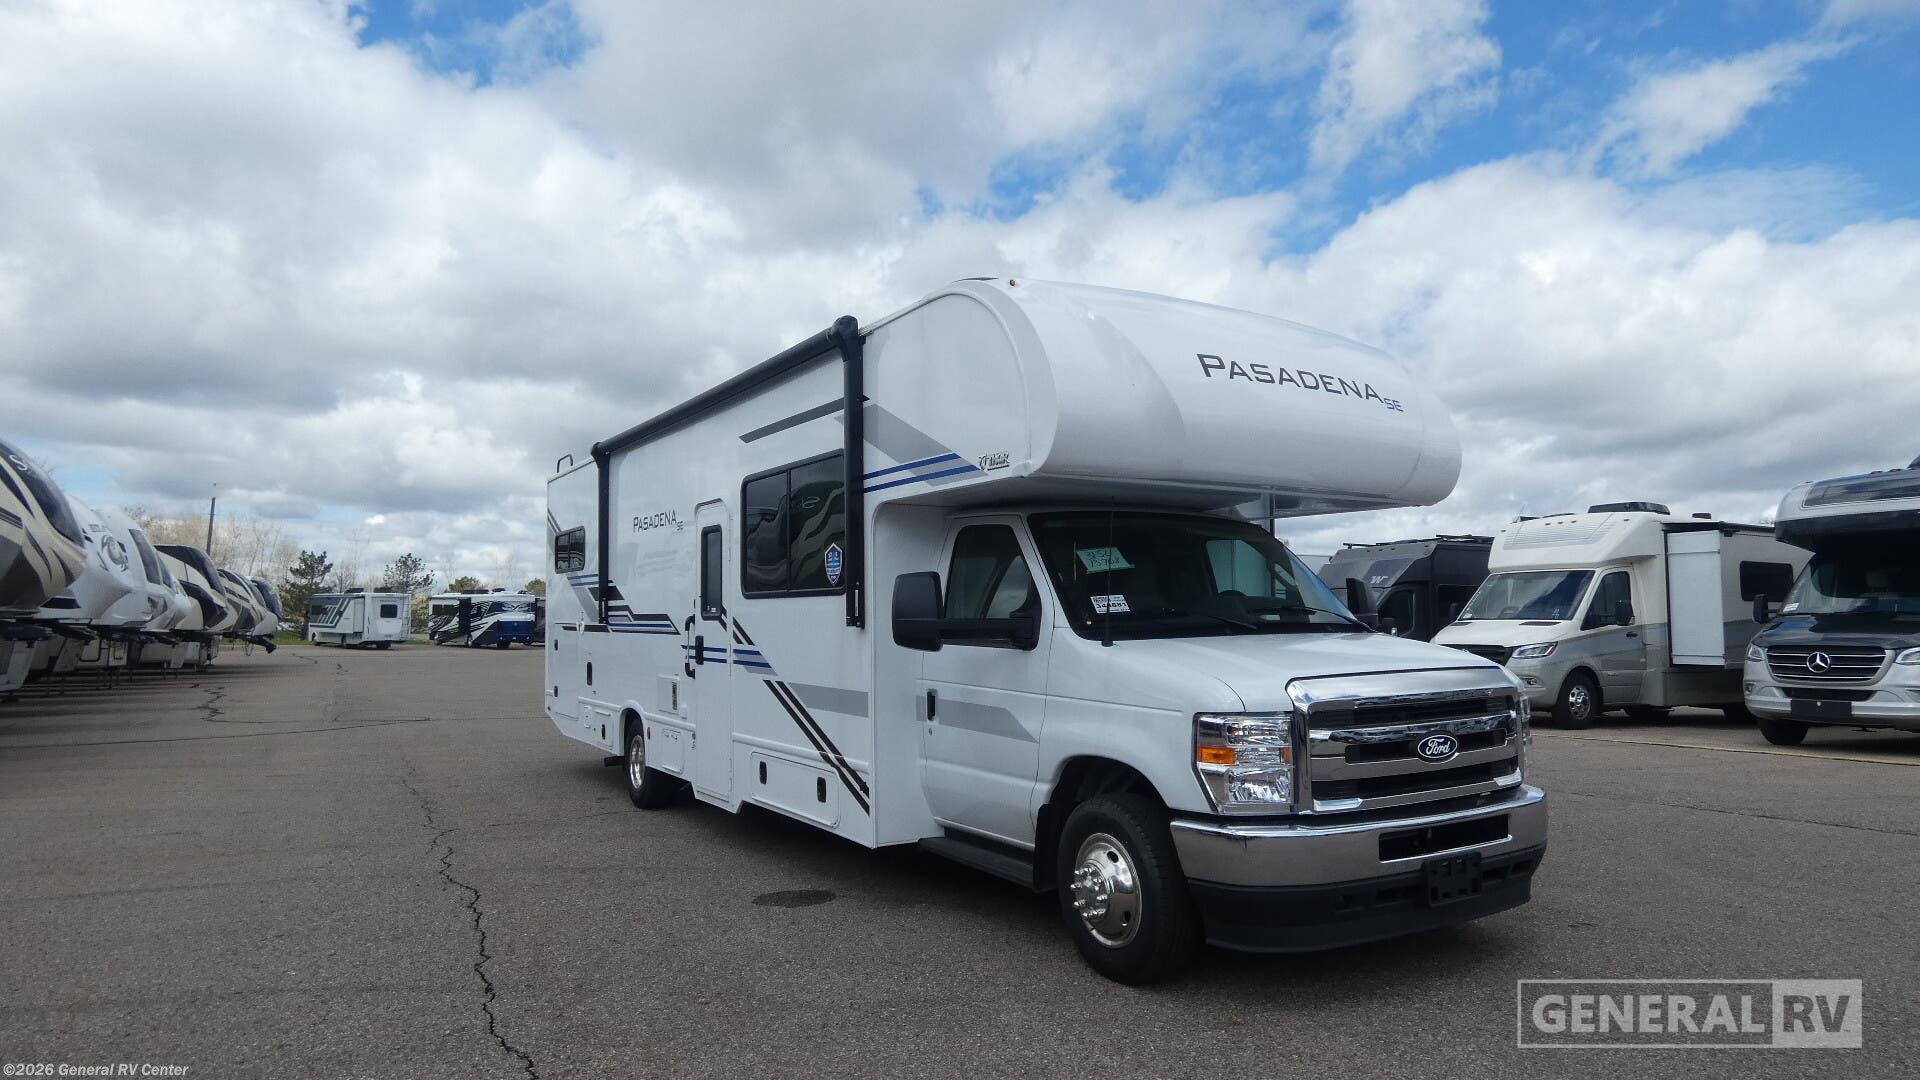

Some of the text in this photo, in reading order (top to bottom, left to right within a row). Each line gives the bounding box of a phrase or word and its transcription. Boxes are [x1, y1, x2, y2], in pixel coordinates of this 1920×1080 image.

[1196, 353, 1404, 412] PASADENA SE
[632, 509, 677, 533] PASADENA
[1425, 738, 1451, 755] Ford
